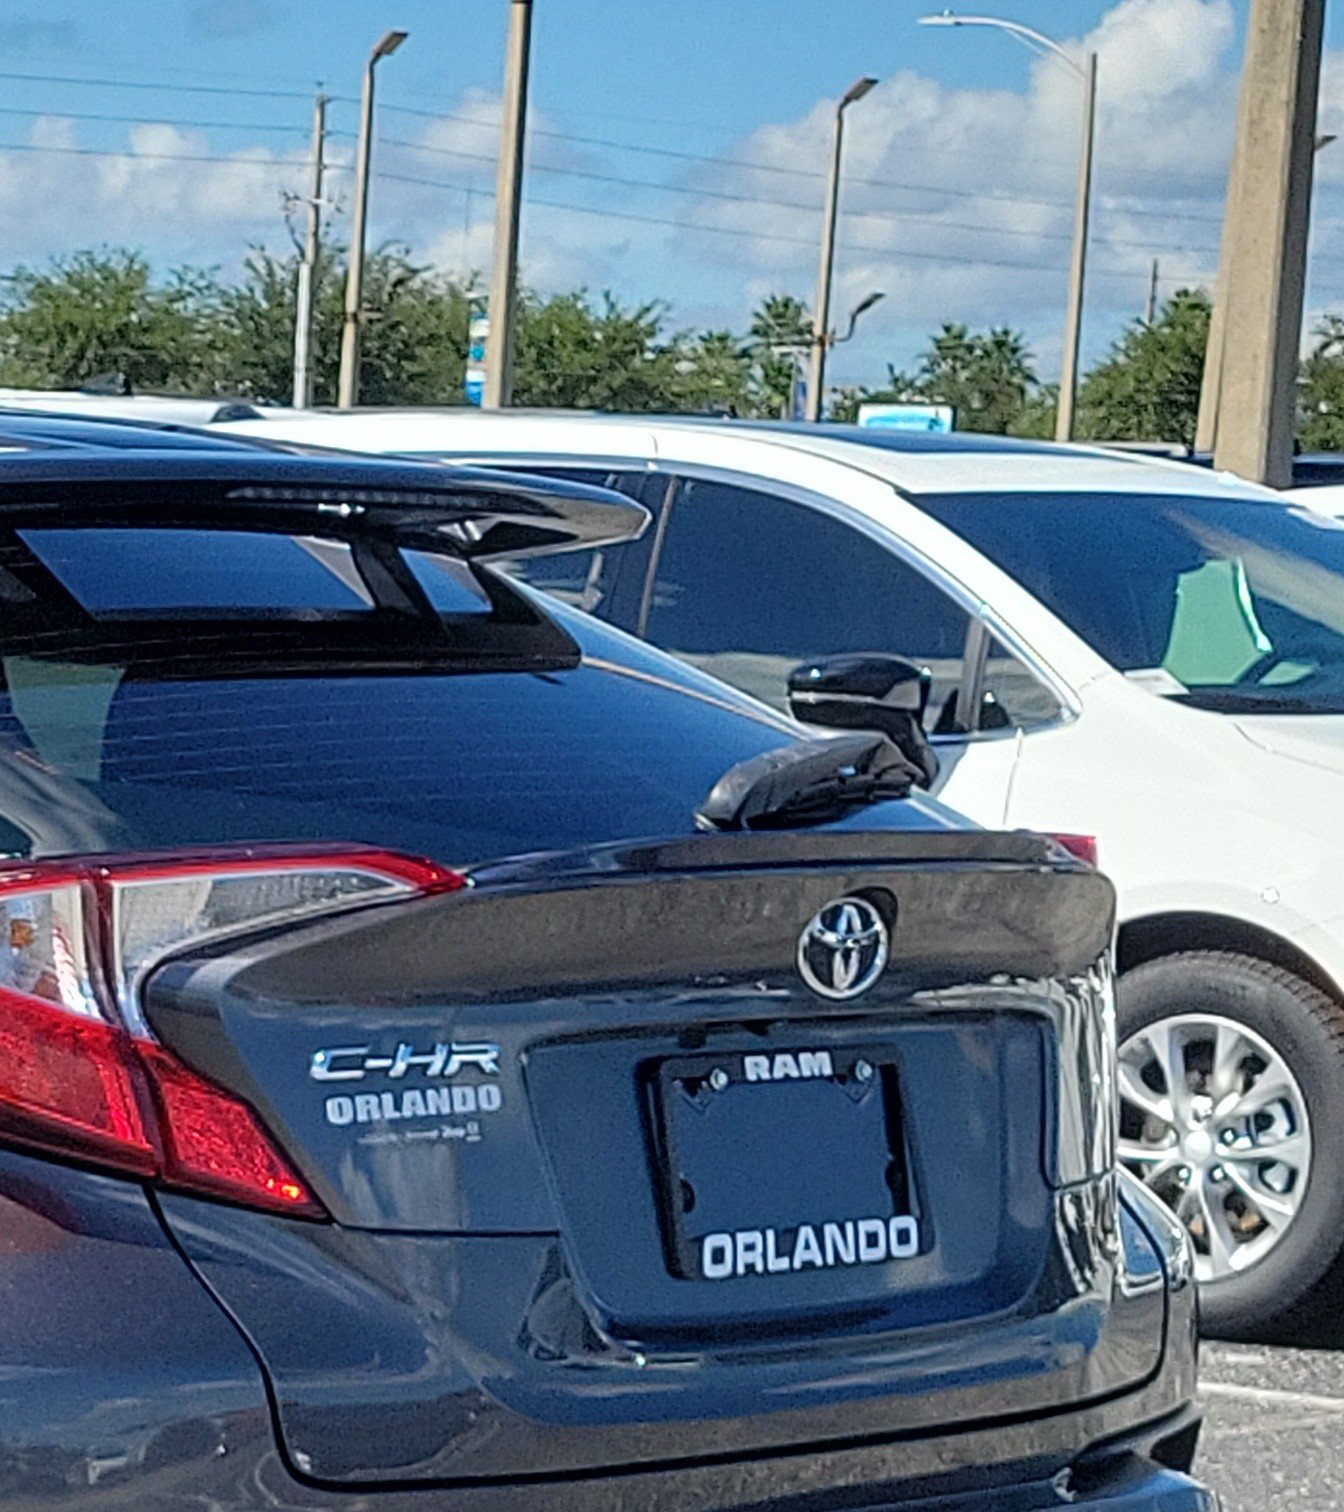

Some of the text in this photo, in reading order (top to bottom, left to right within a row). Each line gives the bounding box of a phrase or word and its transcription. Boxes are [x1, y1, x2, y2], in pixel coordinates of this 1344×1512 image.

[310, 1042, 501, 1080] C-HR
[743, 1051, 834, 1082] RAM
[325, 1083, 502, 1125] ORLANDO
[702, 1215, 919, 1279] ORLANDO
